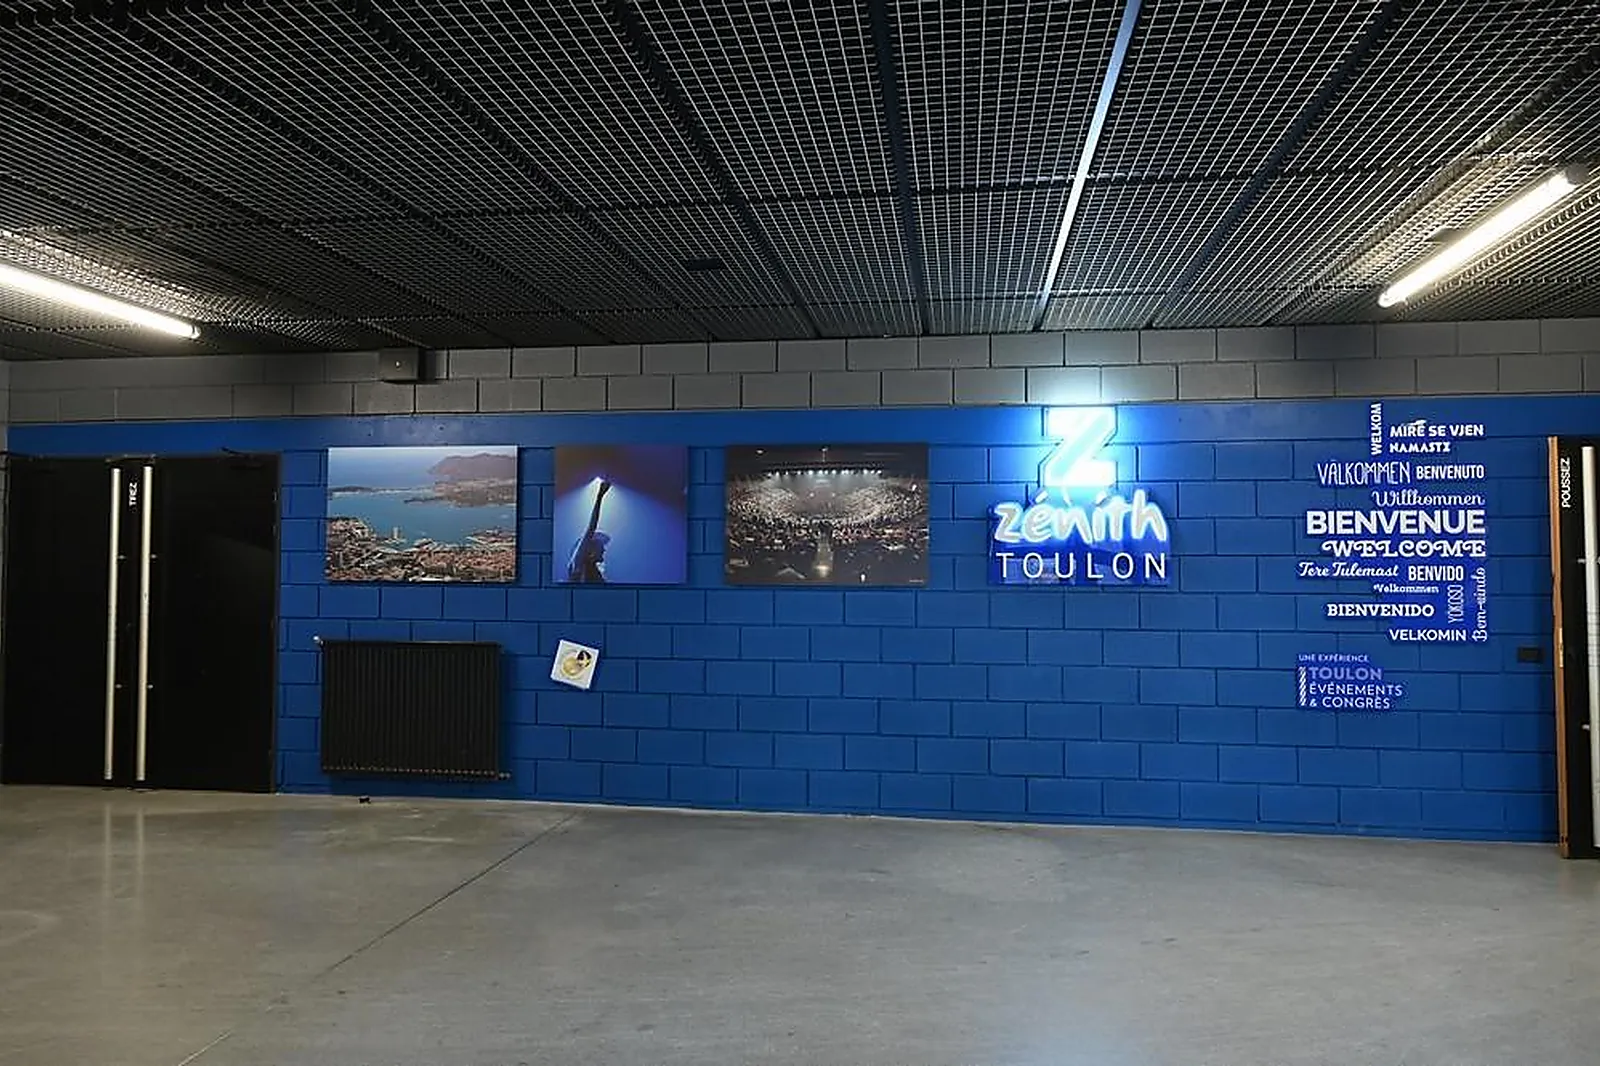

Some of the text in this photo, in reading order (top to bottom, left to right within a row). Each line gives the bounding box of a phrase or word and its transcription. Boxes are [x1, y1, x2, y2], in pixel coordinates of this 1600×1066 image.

[1371, 403, 1382, 455] WELKOM
[1429, 425, 1446, 437] SE
[1449, 424, 1484, 436] VJEN
[1416, 465, 1485, 480] BENVENUTO
[1560, 457, 1570, 508] POUSSEZ
[1372, 489, 1485, 506] Willkommen
[1307, 510, 1485, 535] BIENVENUE
[1322, 540, 1486, 558] WELCOME
[996, 552, 1166, 579] TOULON
[1299, 562, 1399, 577] Tere Tulemast
[1408, 565, 1464, 582] BENVIDO
[1327, 604, 1434, 617] BIENVENIDO
[1390, 629, 1466, 641] VELKOMIN
[1309, 667, 1382, 681] TOULON
